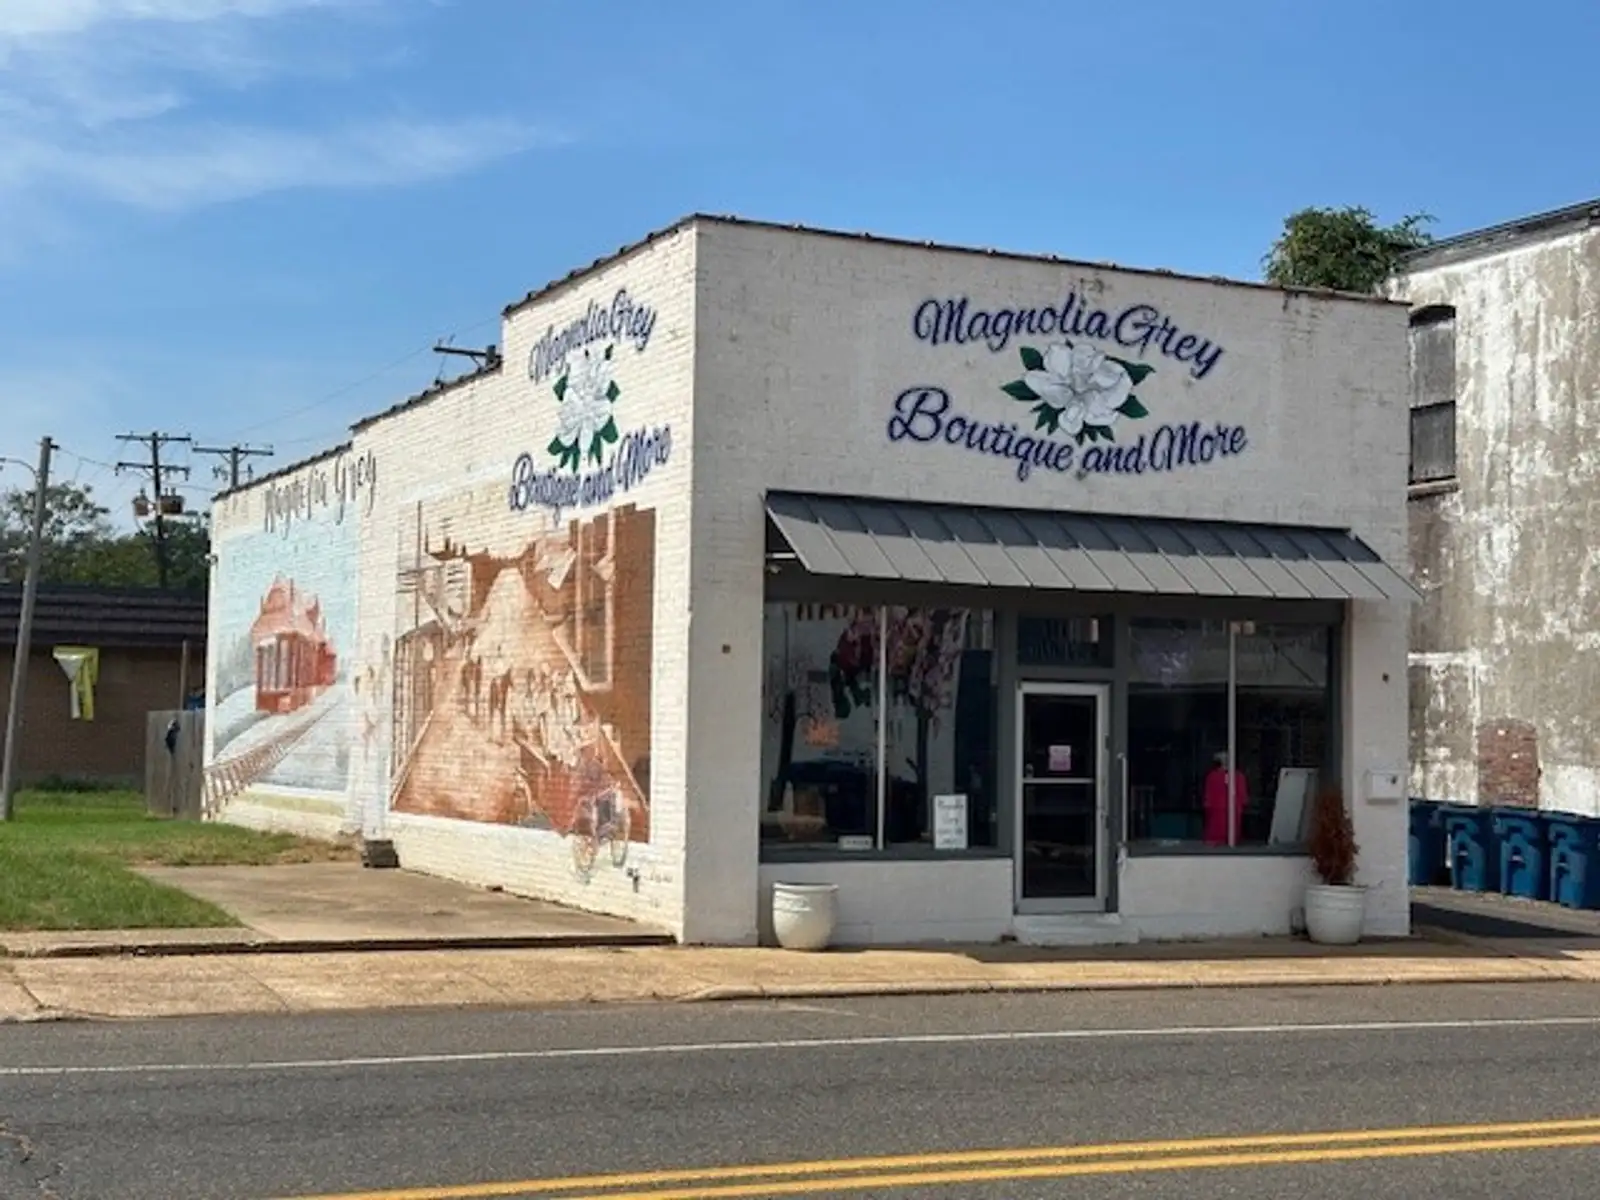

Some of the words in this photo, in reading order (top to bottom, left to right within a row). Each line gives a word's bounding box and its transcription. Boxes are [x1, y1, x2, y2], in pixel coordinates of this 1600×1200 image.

[529, 298, 609, 385] Magnolia
[609, 289, 657, 351] Grey
[913, 292, 1111, 353] Magnolia
[1114, 304, 1224, 379] Grey
[509, 451, 580, 527] Boutique
[581, 455, 614, 502] and
[617, 425, 672, 492] More
[888, 387, 1074, 482] Boutique
[1082, 440, 1144, 475] and
[1148, 422, 1249, 473] More
